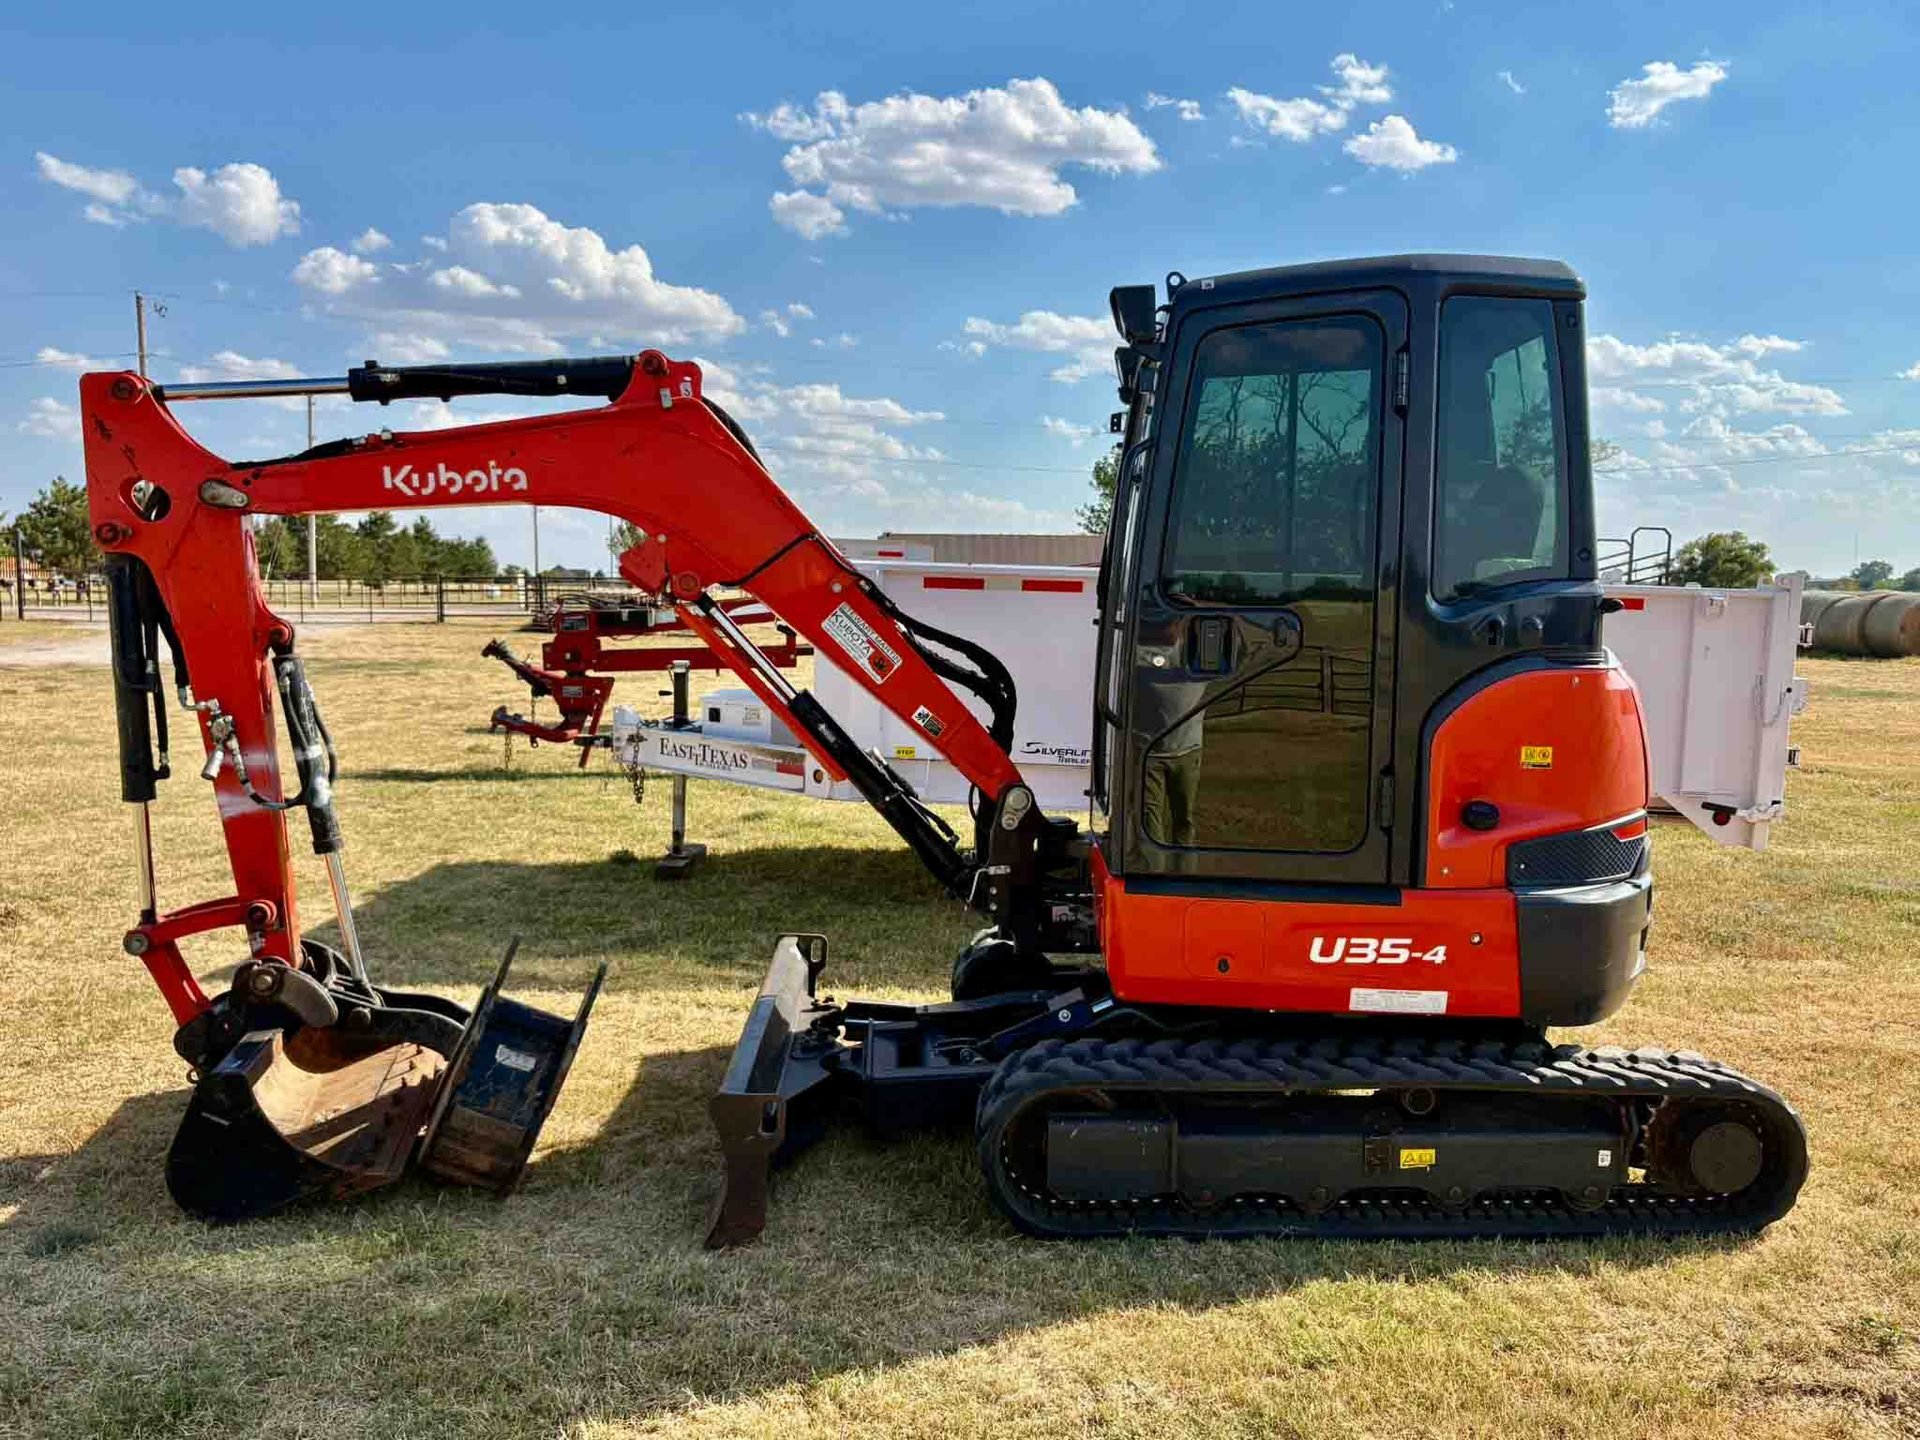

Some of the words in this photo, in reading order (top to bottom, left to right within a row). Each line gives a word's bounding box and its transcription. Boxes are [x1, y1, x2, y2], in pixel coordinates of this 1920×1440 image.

[383, 460, 528, 496] Kubota
[831, 610, 871, 654] KUBOTA
[660, 737, 695, 760] EAST
[699, 743, 748, 769] TEXAS
[1020, 741, 1092, 757] SILVERLIN
[1309, 937, 1447, 964] U35-4
